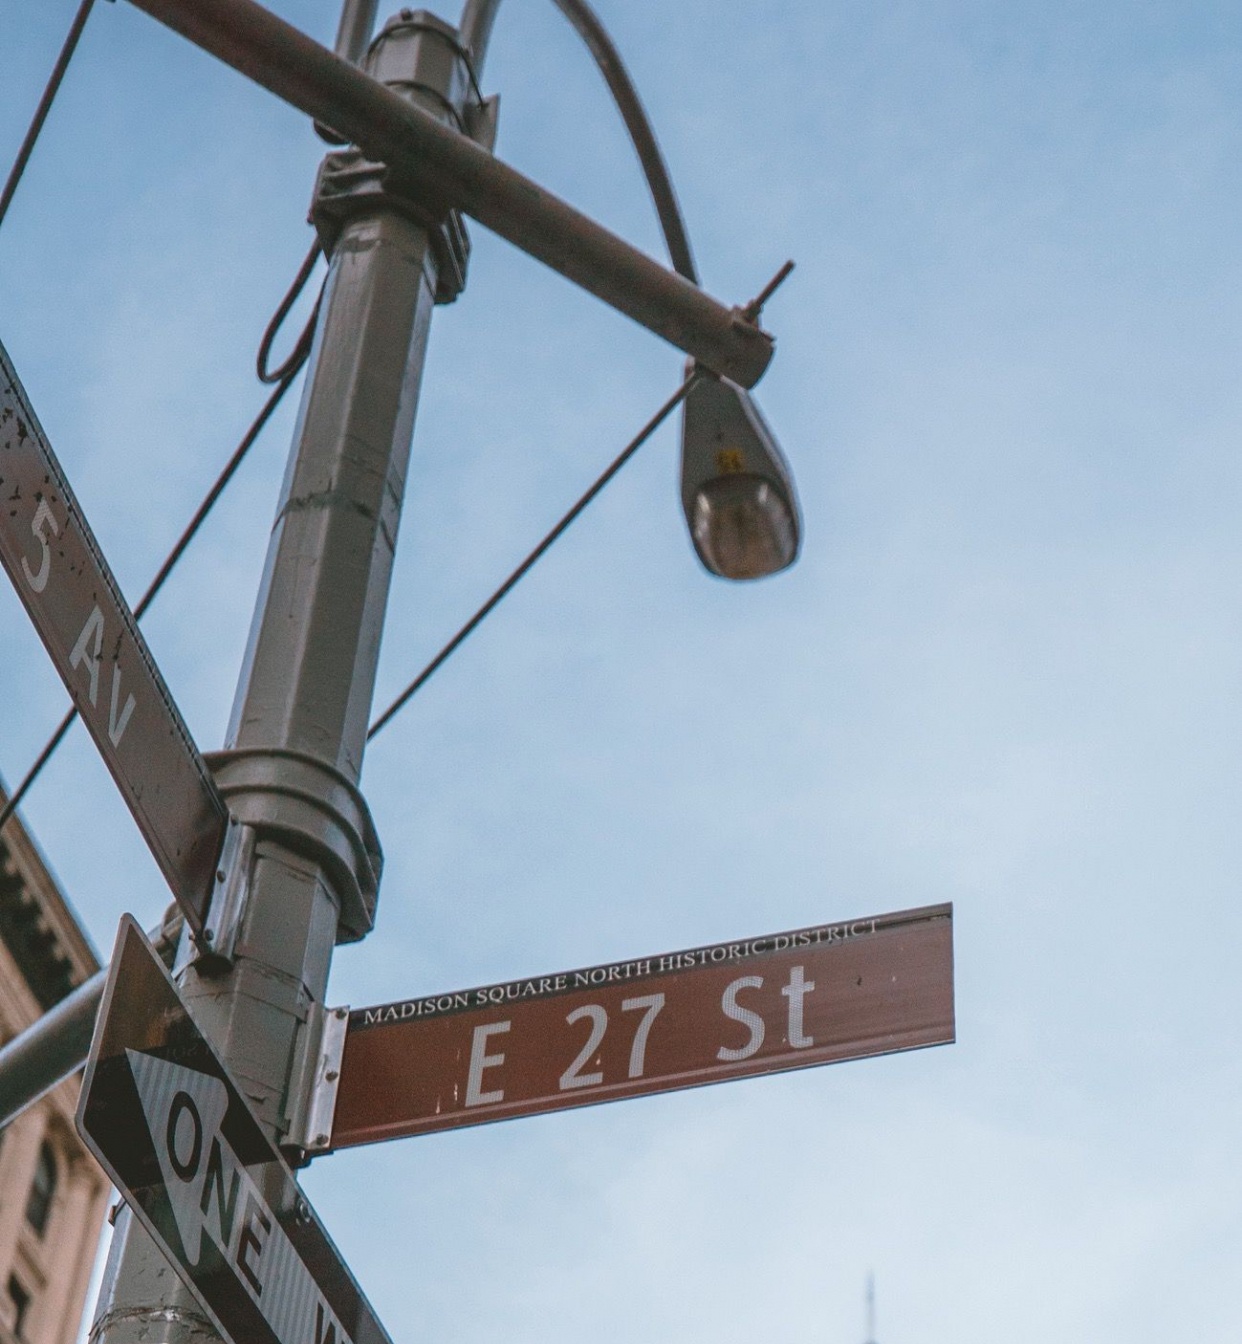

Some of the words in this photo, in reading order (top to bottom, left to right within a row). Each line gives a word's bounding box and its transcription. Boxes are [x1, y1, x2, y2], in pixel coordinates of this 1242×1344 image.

[21, 496, 59, 594] 5
[69, 604, 137, 749] AV
[364, 992, 469, 1025] MADISON
[476, 974, 567, 1005] SQUARE
[574, 959, 651, 988] NORTH
[658, 938, 767, 972] HISTORIC
[774, 918, 881, 951] DISTRICT
[464, 1020, 512, 1108] E
[559, 992, 666, 1090] 27
[716, 965, 816, 1062] St
[167, 1090, 272, 1297] ONE
